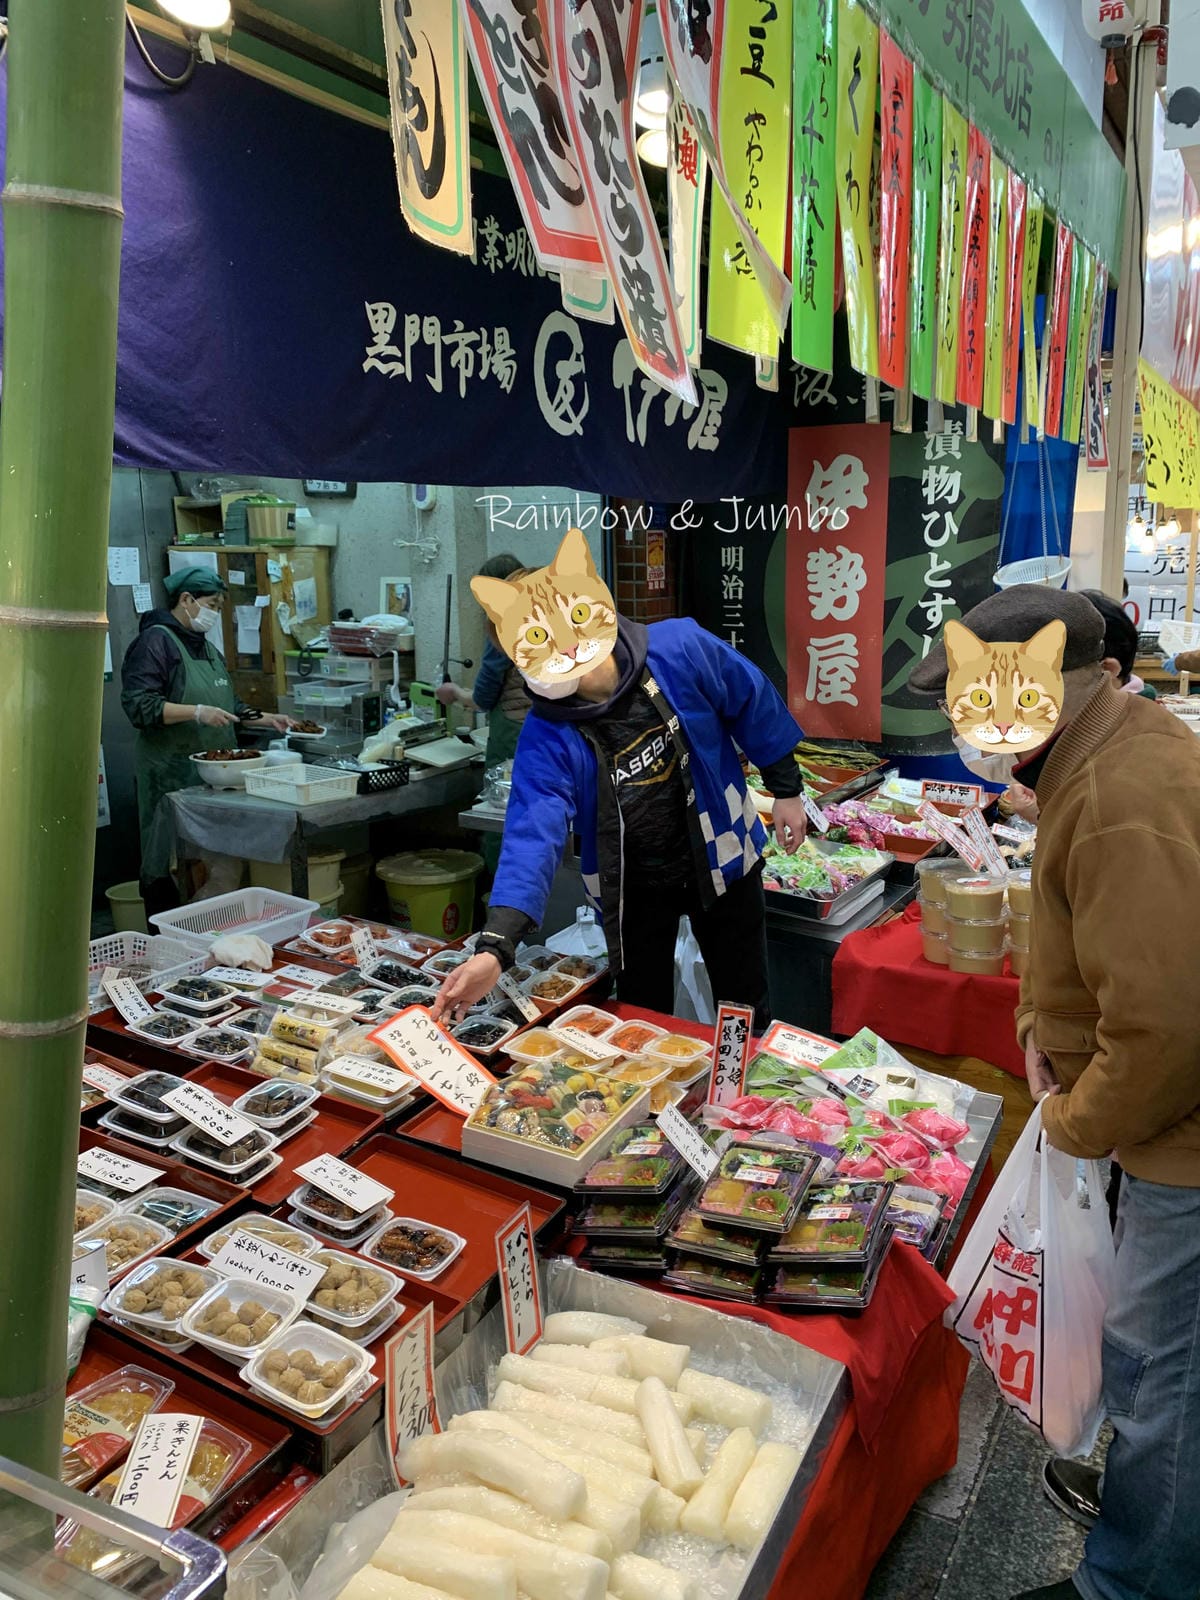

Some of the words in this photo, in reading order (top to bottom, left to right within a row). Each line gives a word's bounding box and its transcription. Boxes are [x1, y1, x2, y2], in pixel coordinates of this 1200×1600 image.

[363, 301, 518, 399] 黒門市場
[805, 454, 871, 708] 伊勢屋
[611, 731, 673, 786] ASEB
[412, 1014, 452, 1058] おせち
[515, 1224, 534, 1302] べったら
[158, 1419, 190, 1482] 栗きんとん
